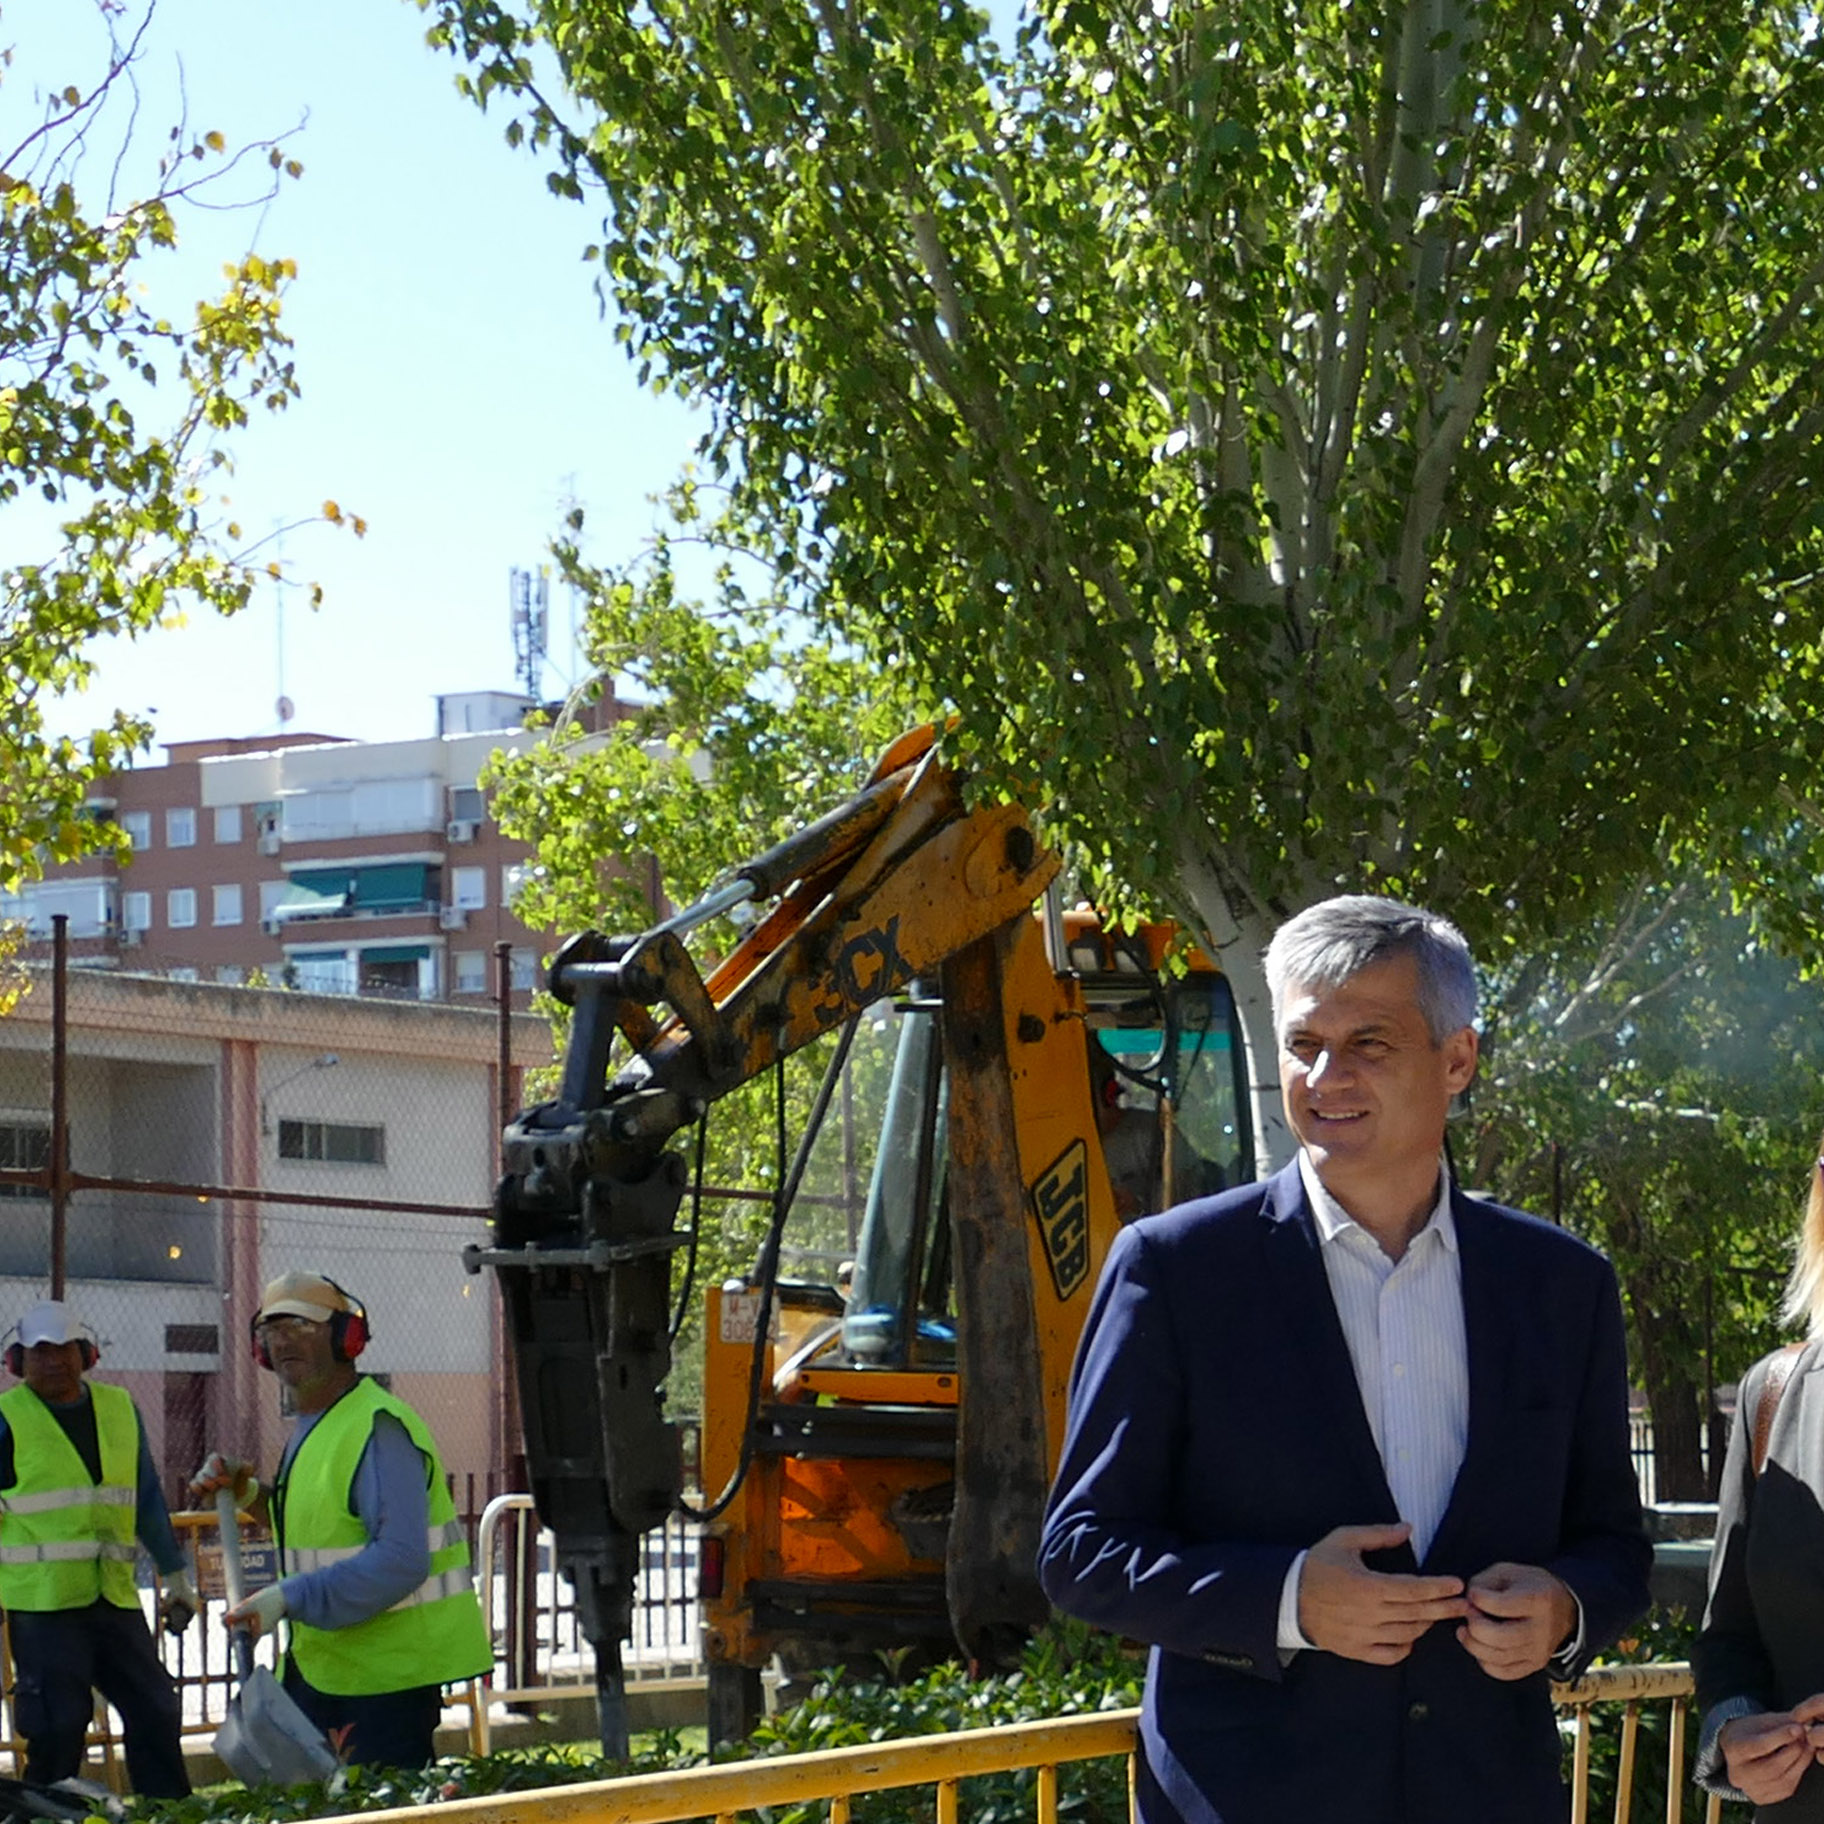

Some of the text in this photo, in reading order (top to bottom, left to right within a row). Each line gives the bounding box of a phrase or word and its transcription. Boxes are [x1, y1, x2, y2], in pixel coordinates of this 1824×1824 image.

[1038, 1162, 1086, 1289] JCB
[728, 1294, 764, 1317] M-V
[723, 1317, 777, 1343] 3082
